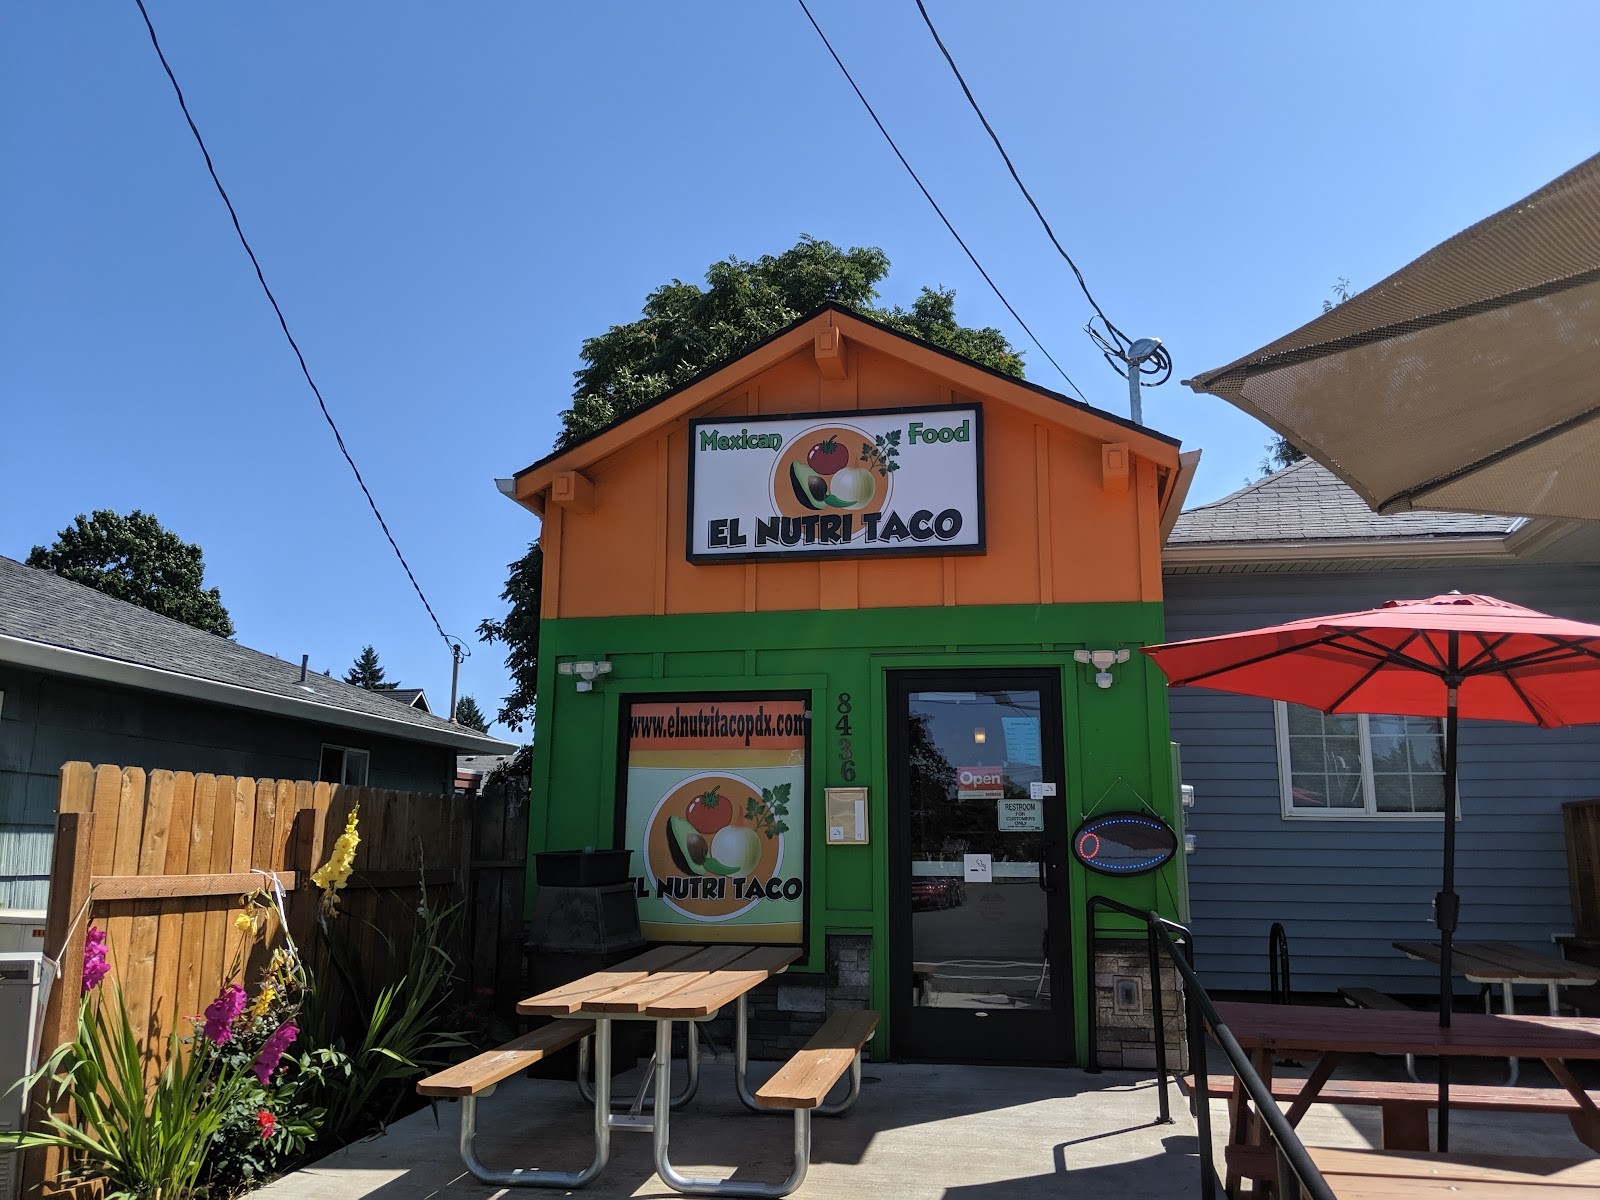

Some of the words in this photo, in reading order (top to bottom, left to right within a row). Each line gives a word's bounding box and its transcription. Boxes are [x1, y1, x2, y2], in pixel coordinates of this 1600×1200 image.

[700, 430, 783, 451] Mexican
[908, 420, 970, 444] Food
[708, 518, 746, 548] EL
[755, 513, 853, 547] NUTRI
[862, 508, 963, 544] TACO
[835, 693, 857, 782] 8436
[960, 771, 1001, 788] Open
[1004, 803, 1036, 811] RESTROOM
[656, 877, 727, 900] NUTRI
[732, 876, 803, 902] TACO
